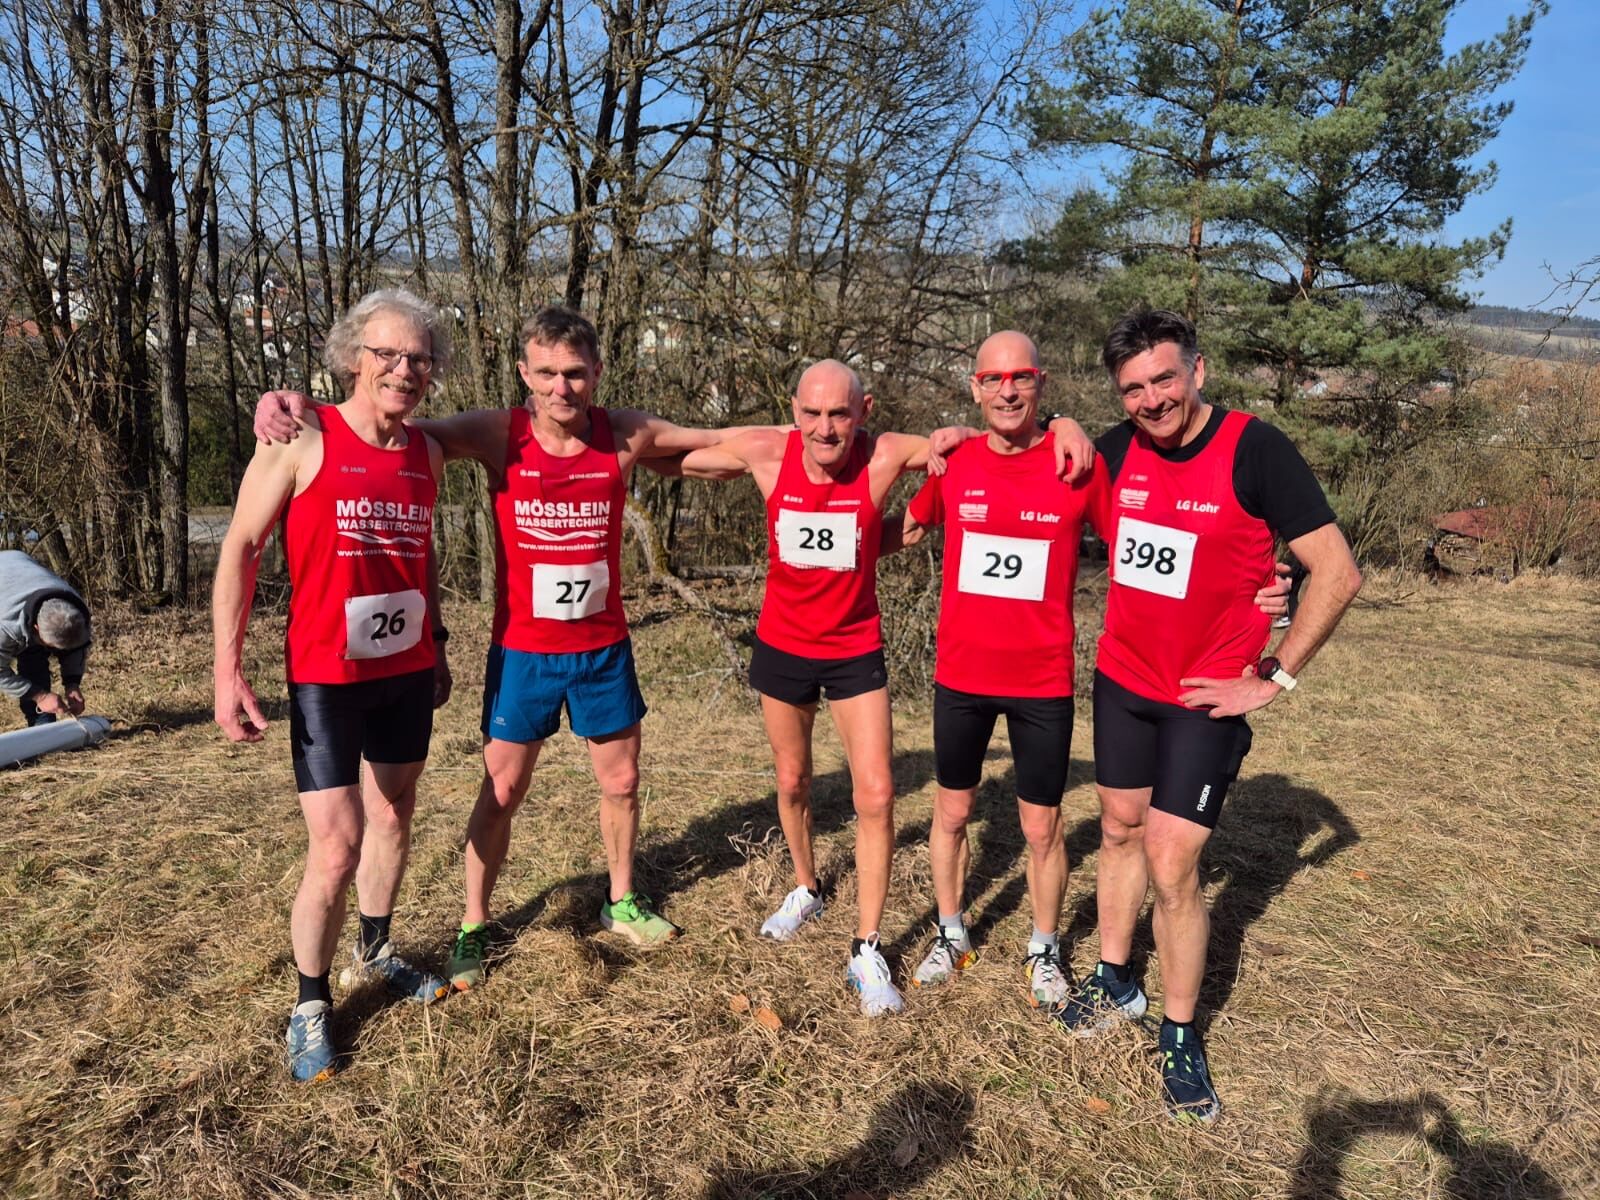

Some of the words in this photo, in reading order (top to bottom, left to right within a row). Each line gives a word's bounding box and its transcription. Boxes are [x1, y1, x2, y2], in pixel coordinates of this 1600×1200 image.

[336, 497, 431, 522] MÖSSLEIN
[514, 499, 610, 518] MÖSSLEIN
[1020, 511, 1035, 522] LG
[1037, 512, 1061, 524] Lohr
[1176, 500, 1190, 511] LG
[1192, 501, 1220, 513] Lohr
[337, 519, 430, 534] WASSERTECHNIK
[515, 516, 609, 529] WASSERTECHNIK
[799, 527, 834, 551] 28
[982, 552, 1023, 579] 29
[1120, 537, 1177, 575] 398
[555, 579, 591, 604] 27
[371, 608, 406, 640] 26
[1196, 784, 1212, 812] FUSION
